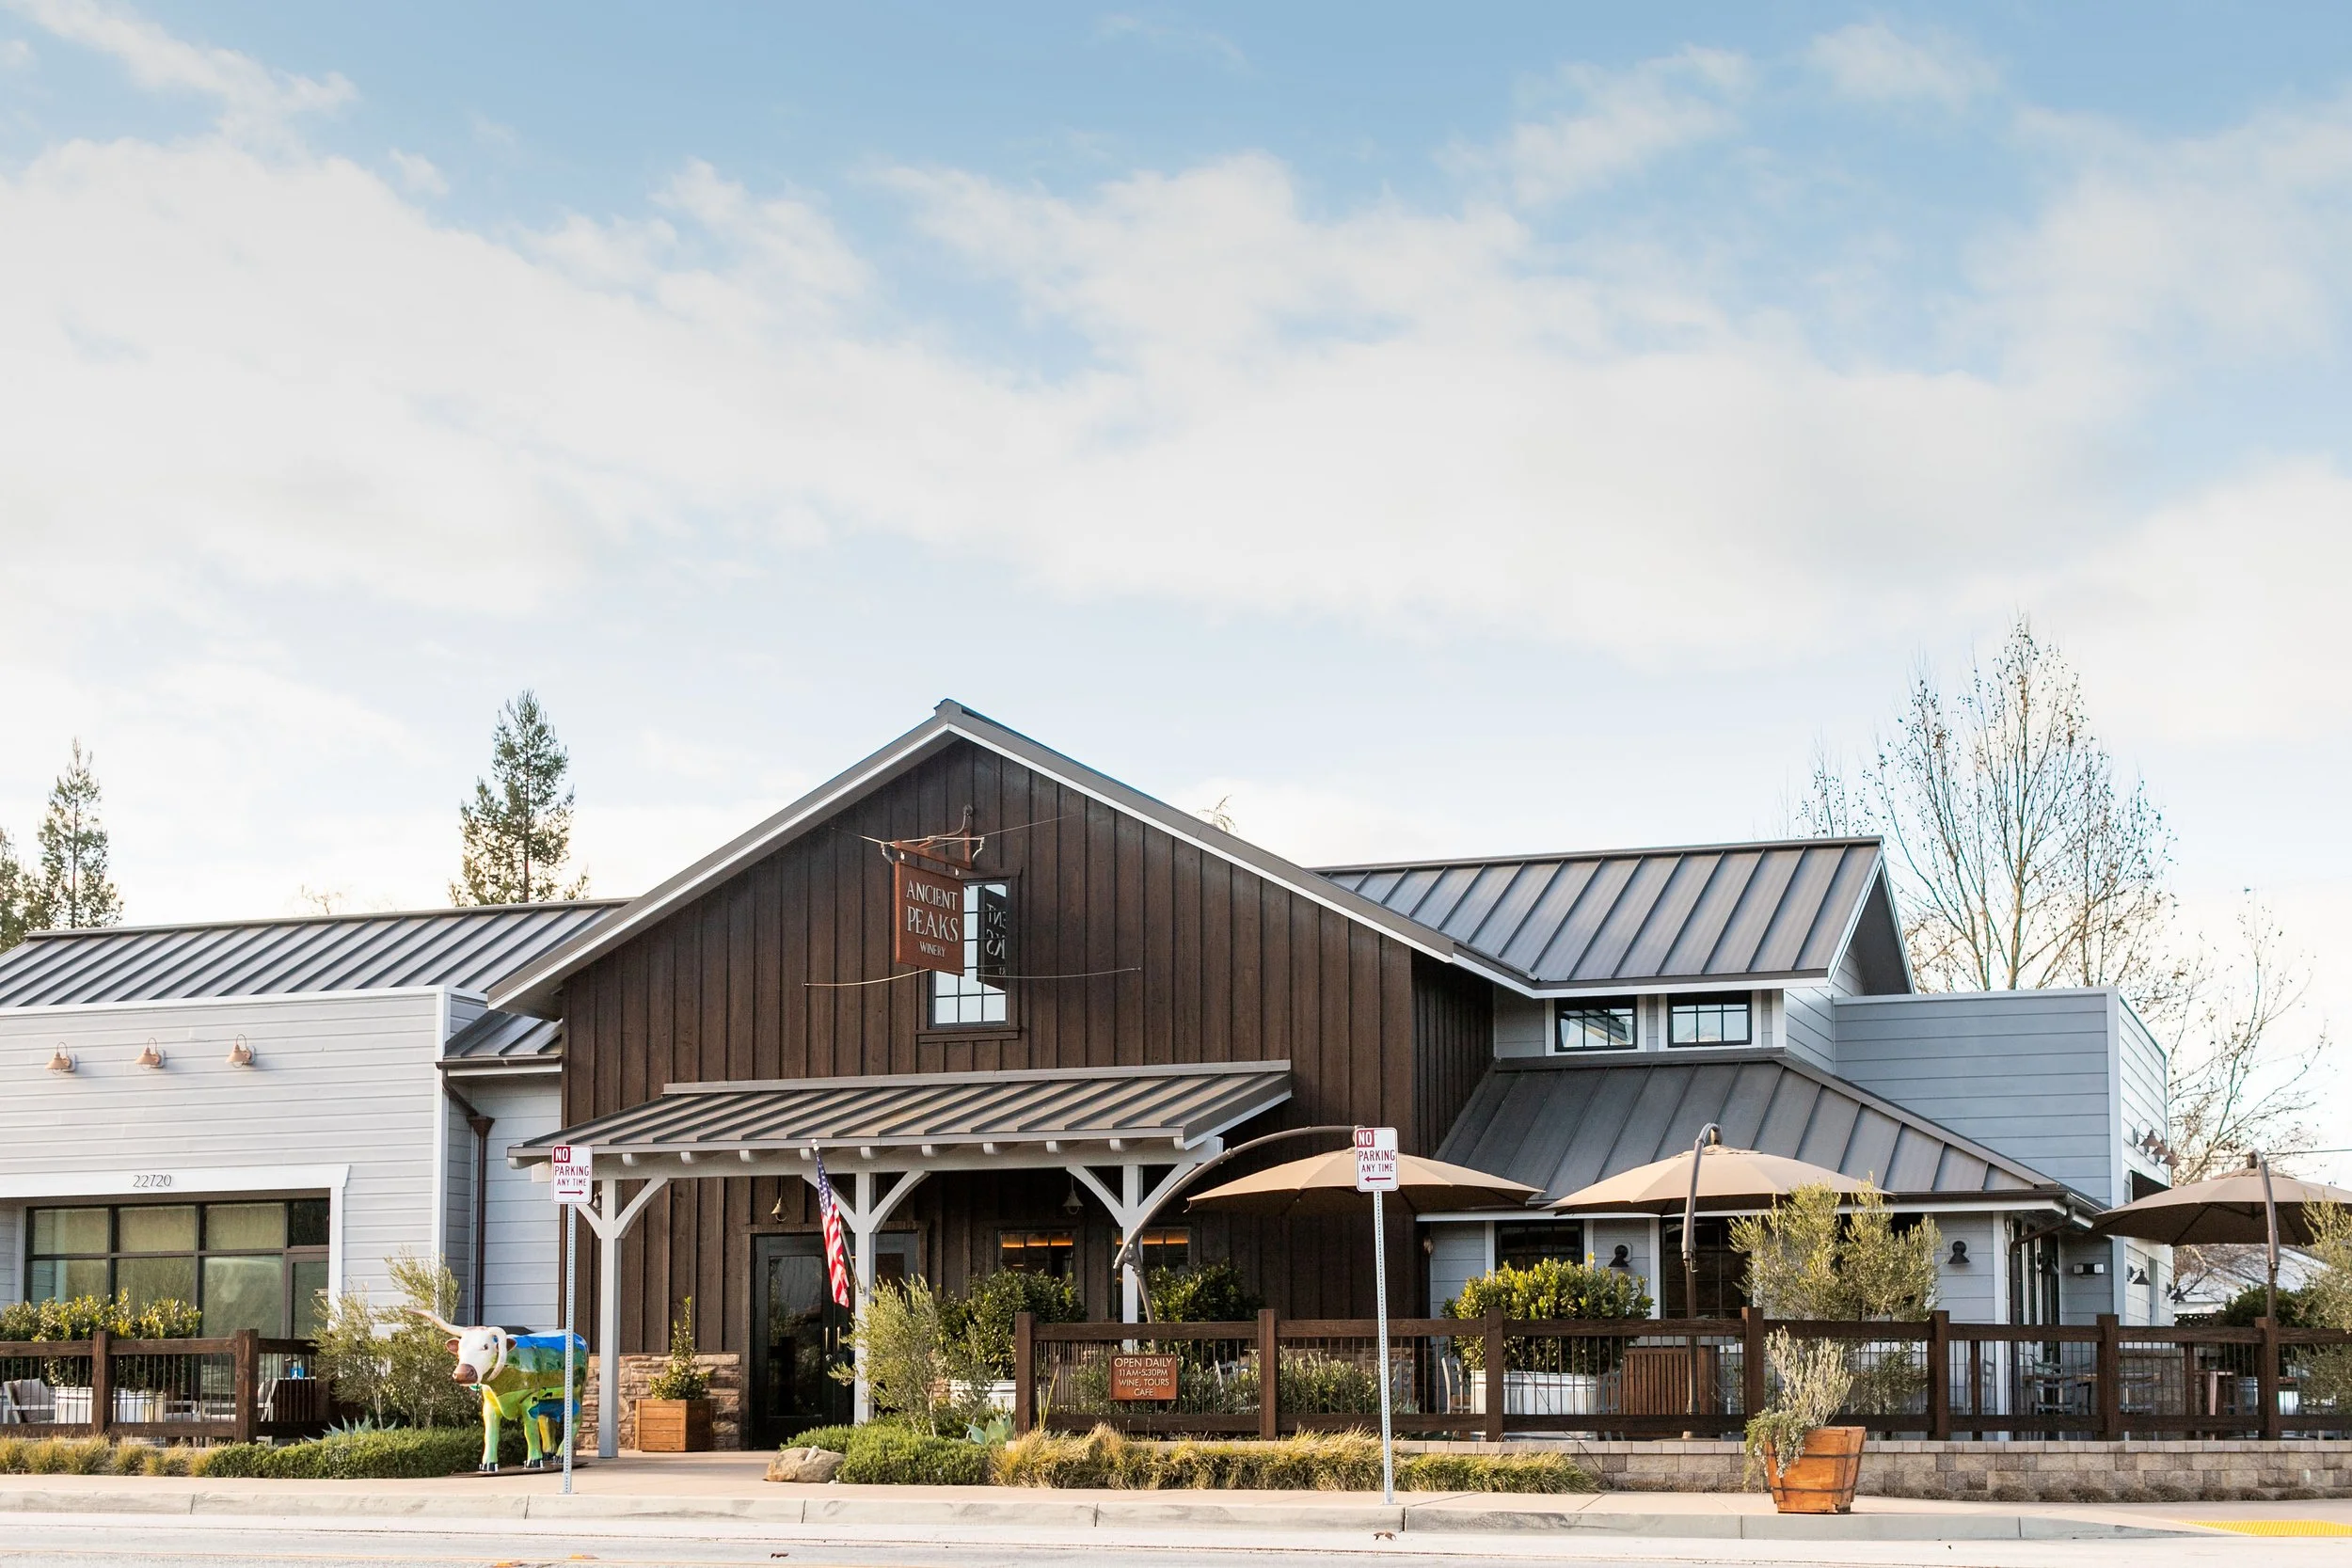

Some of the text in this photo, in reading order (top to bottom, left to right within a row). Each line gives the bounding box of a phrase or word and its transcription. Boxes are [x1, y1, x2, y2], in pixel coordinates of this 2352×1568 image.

[906, 879, 958, 911] ANCIENT
[907, 905, 958, 942] PEAKS
[919, 941, 946, 958] WINERY
[1358, 1131, 1373, 1146] NO
[555, 1148, 569, 1162] NO
[1358, 1149, 1395, 1162] PARKING
[554, 1165, 590, 1177] PARKING
[1361, 1163, 1393, 1173] ANY TIME
[133, 1174, 172, 1188] 22720
[557, 1178, 587, 1187] ANY TIME
[1114, 1357, 1173, 1368] OPEN DAILY
[1119, 1378, 1170, 1386] WINE, TOURS
[1134, 1388, 1153, 1397] CAFE
